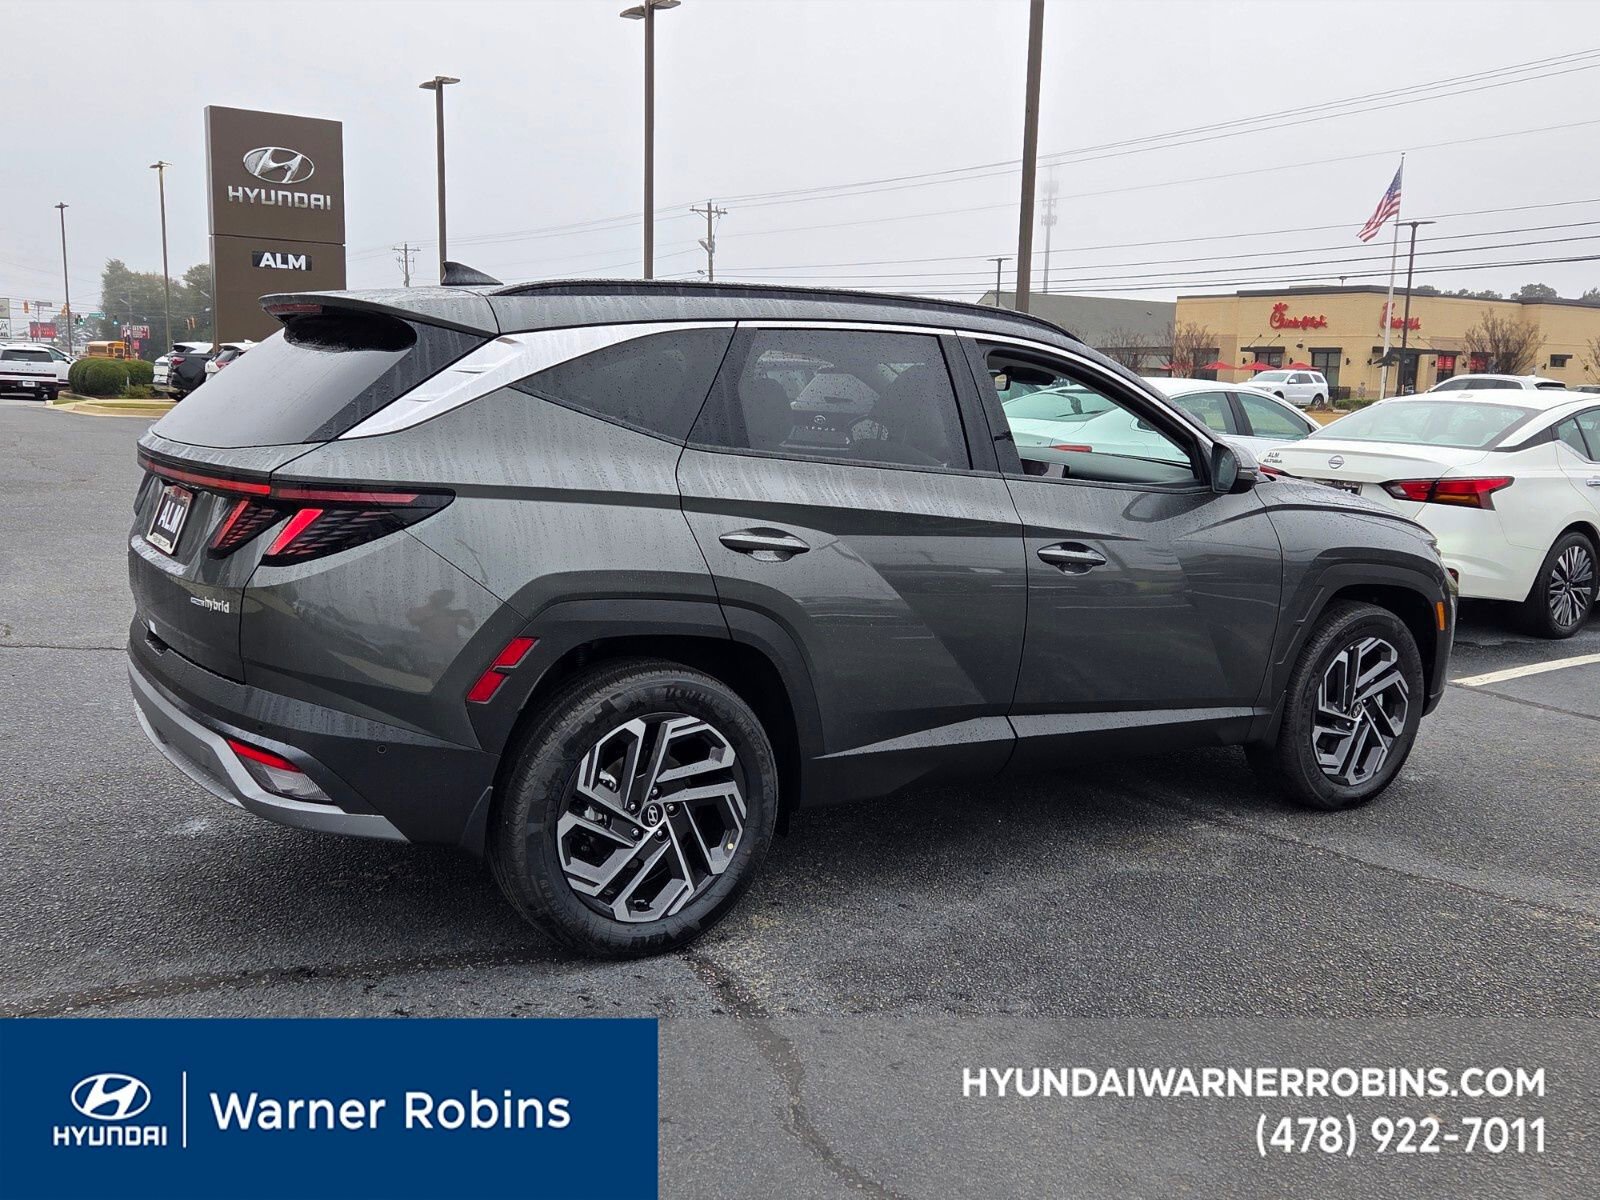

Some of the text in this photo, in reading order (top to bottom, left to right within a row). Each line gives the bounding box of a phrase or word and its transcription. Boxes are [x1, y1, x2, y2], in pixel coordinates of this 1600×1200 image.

[227, 185, 331, 210] HYUNDAI
[259, 252, 306, 271] ALM
[157, 500, 185, 534] ALM
[204, 596, 230, 613] hybrid
